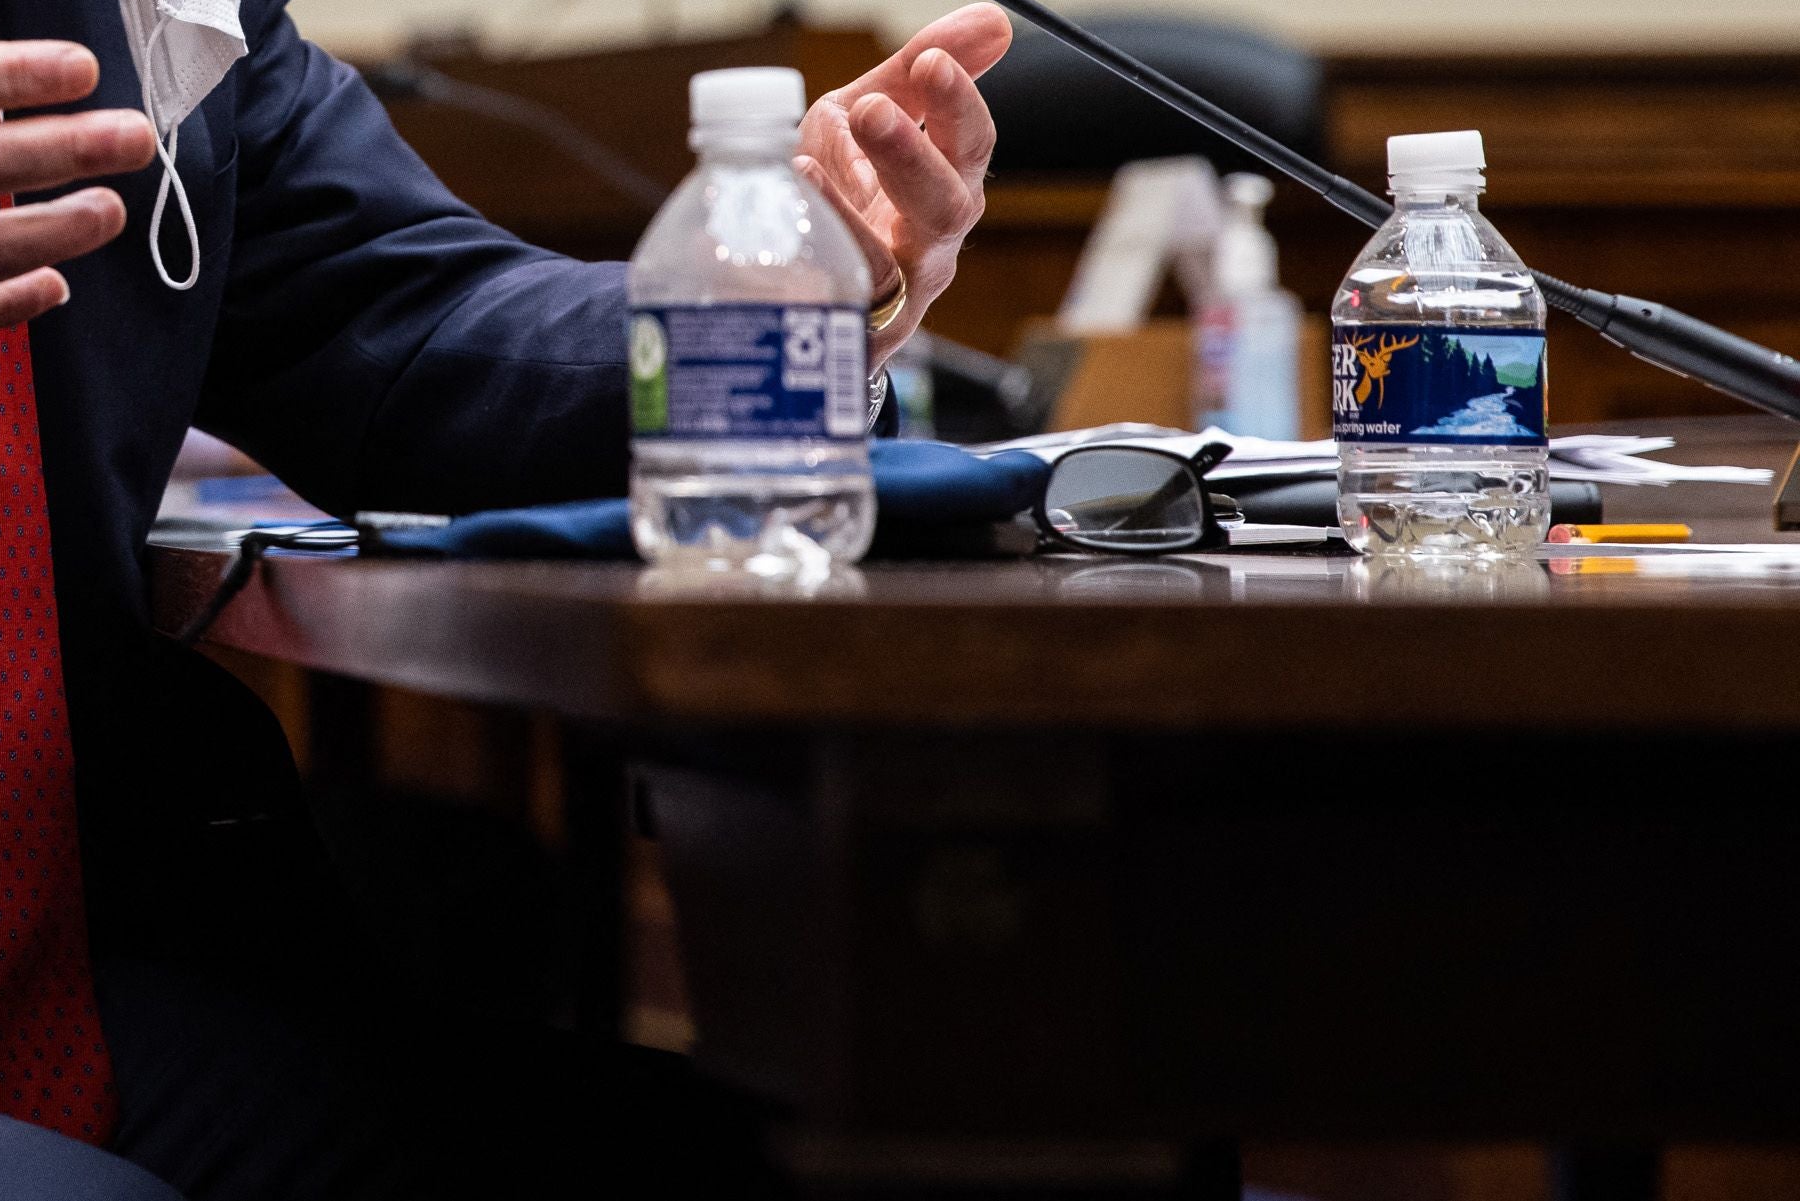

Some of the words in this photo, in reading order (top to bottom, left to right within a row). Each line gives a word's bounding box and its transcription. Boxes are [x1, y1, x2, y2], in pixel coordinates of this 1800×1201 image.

[1331, 343, 1358, 377] ER
[1332, 379, 1360, 416] RK
[1342, 421, 1365, 436] spring
[1365, 420, 1402, 435] water
